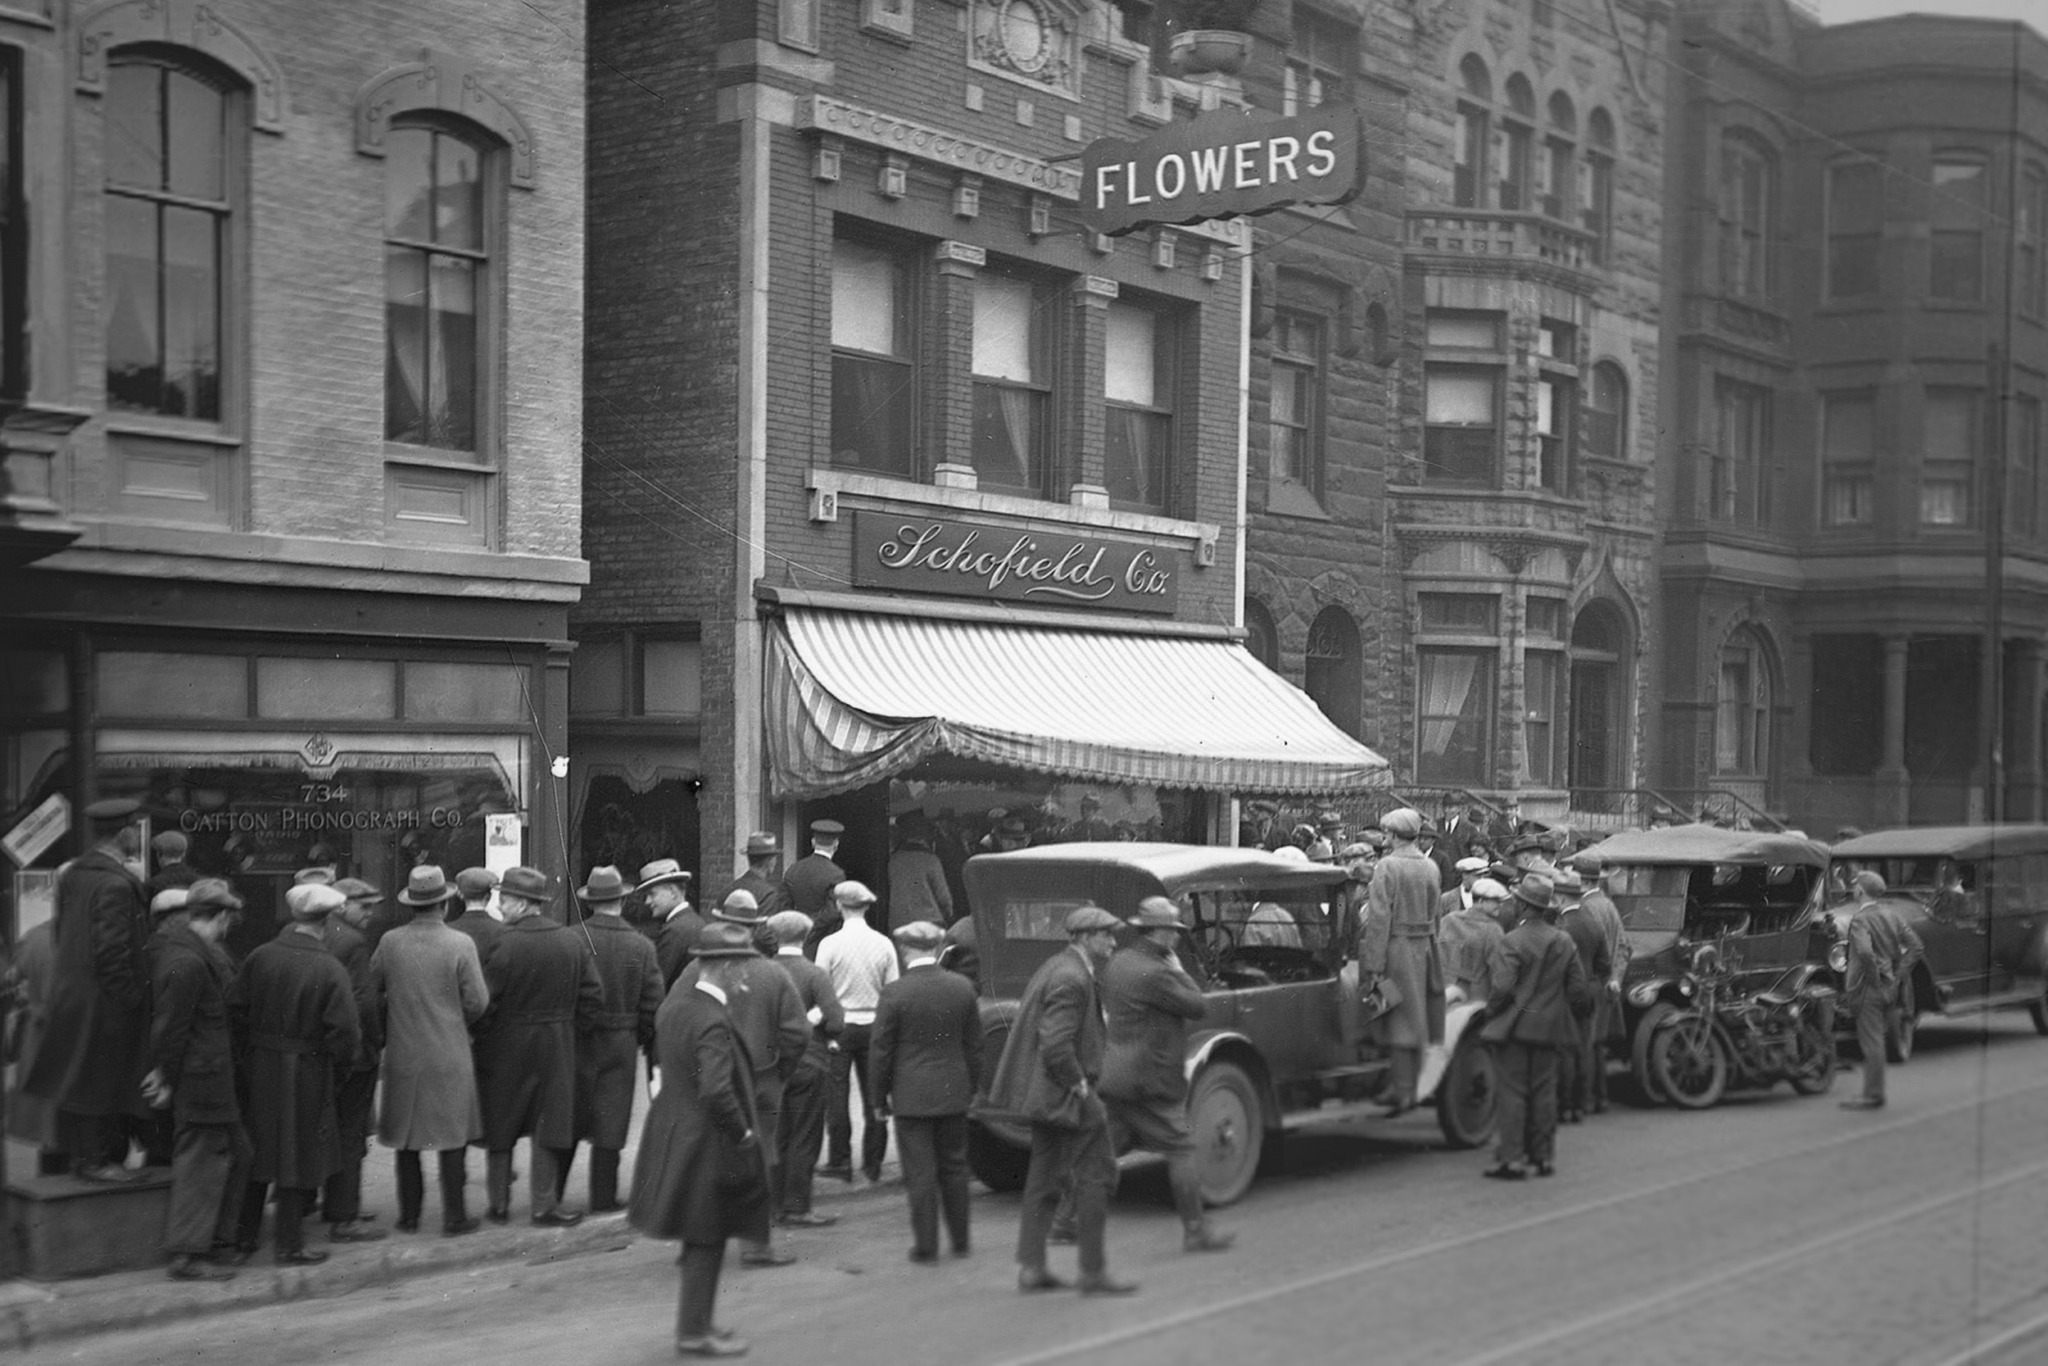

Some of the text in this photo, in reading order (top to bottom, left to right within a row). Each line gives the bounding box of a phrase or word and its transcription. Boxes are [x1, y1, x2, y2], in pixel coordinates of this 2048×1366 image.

[1097, 130, 1335, 209] FLOWERS
[879, 524, 1169, 599] Schofield Co.
[301, 784, 347, 803] 734
[282, 807, 420, 830] PHONOGRAPH
